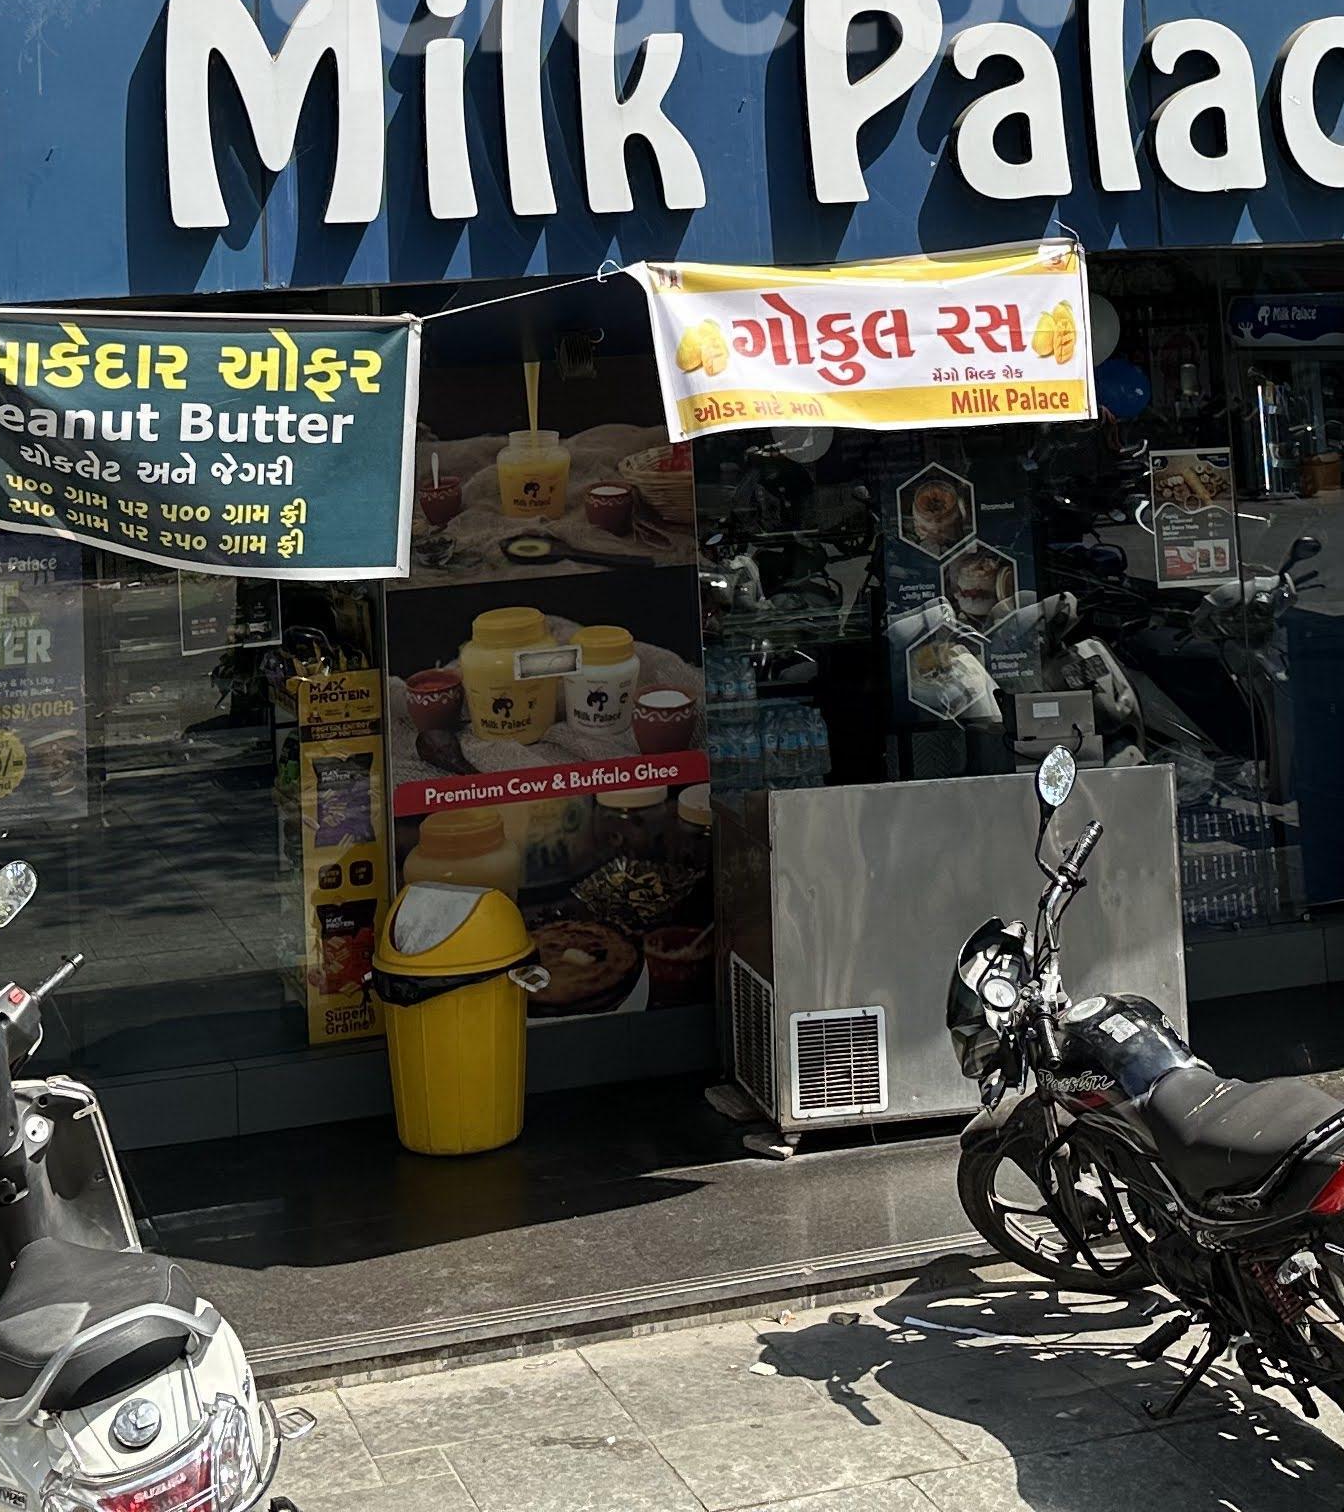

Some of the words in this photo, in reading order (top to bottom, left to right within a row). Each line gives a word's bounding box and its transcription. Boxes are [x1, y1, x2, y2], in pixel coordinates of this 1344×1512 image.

[731, 292, 916, 387] ગોકુલ
[936, 303, 1029, 356] રસ
[217, 328, 384, 403] ઓફર
[951, 388, 1001, 414] Milk
[1005, 386, 1070, 412] Palace
[179, 402, 356, 445] Butter
[19, 441, 123, 484] ચોકલેટ
[136, 452, 197, 486] અને
[8, 555, 58, 573] Palace
[309, 677, 347, 693] MAX
[309, 689, 370, 704] PROTEIN
[424, 782, 505, 806] Premium
[507, 777, 549, 796] Cow
[551, 773, 567, 790] &
[569, 768, 631, 789] Buffalo
[634, 762, 680, 780] Ghee
[1037, 1068, 1116, 1093] Passion
